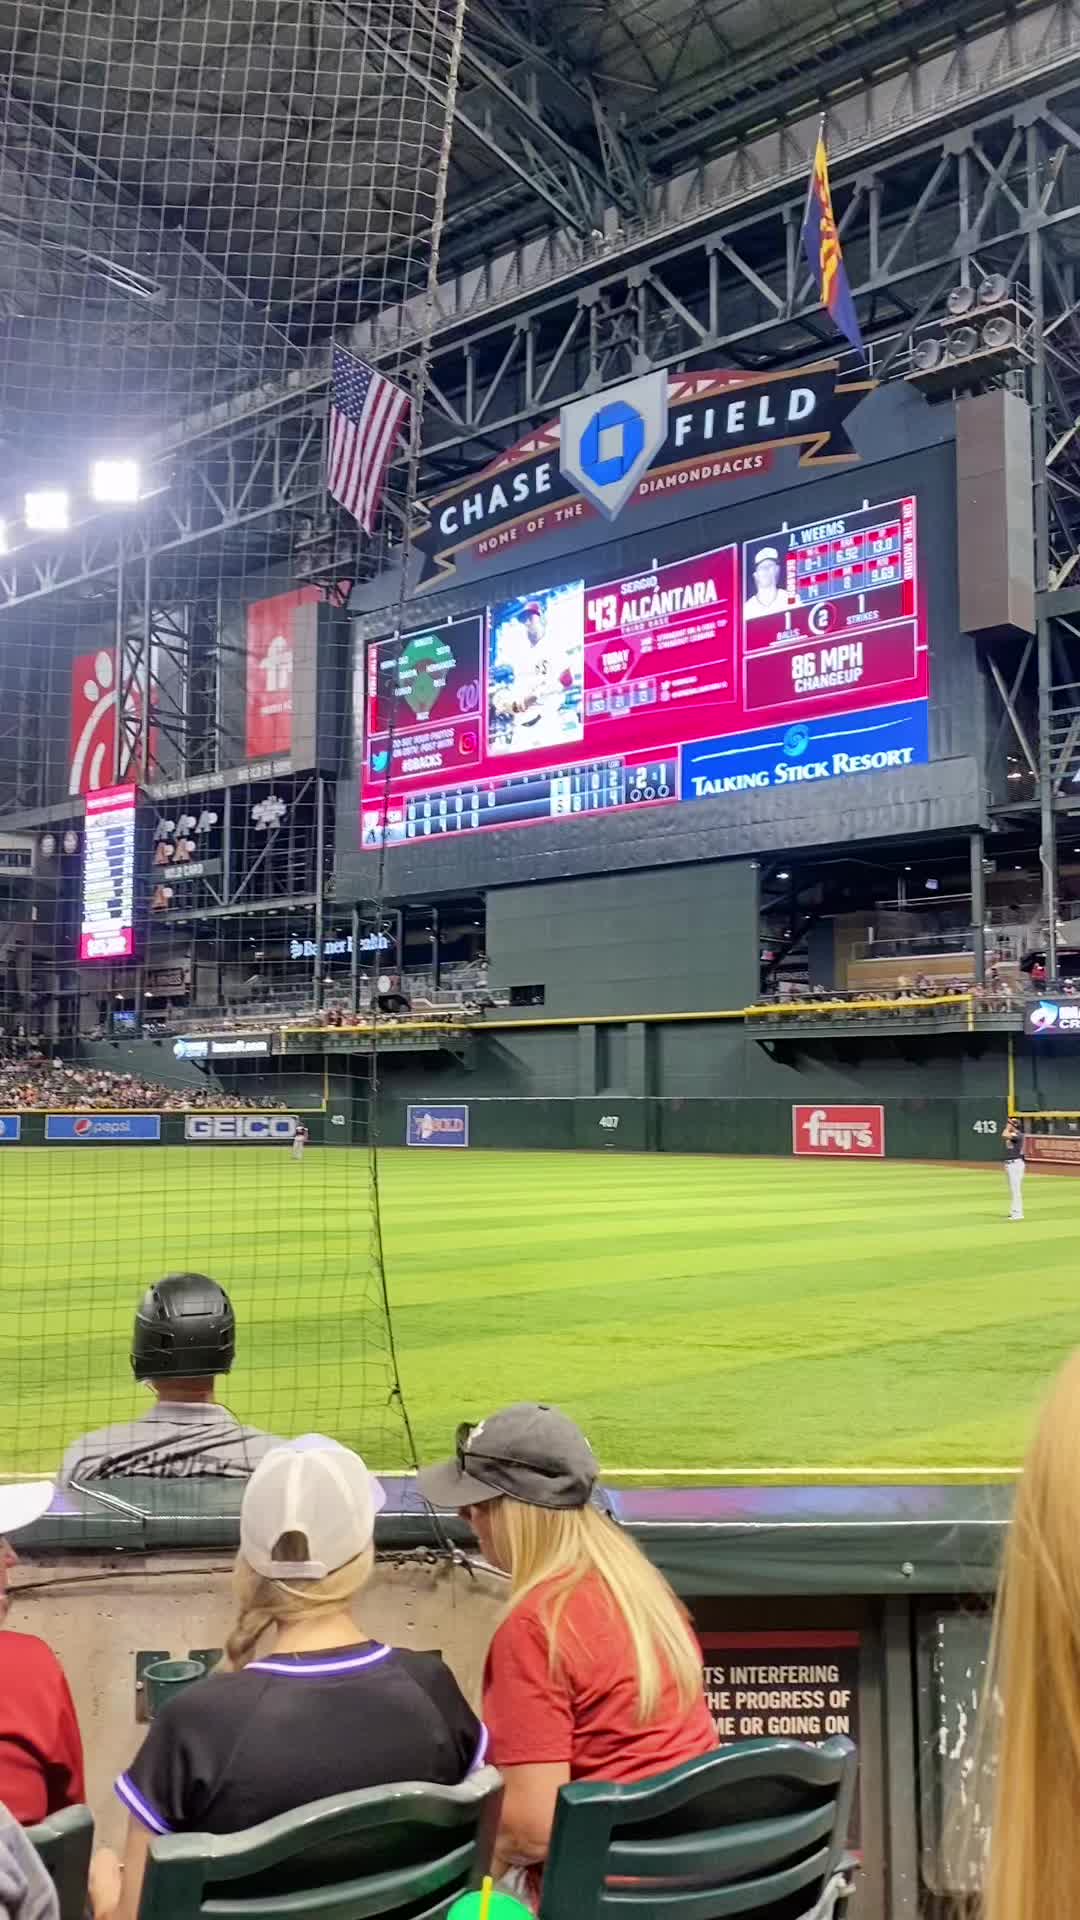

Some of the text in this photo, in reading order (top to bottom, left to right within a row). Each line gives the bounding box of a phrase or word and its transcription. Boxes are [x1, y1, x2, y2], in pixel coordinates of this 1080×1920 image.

[440, 388, 816, 535] CHASE FIELD
[478, 455, 764, 553] HOME OF THE DIAMONDBACKS
[800, 520, 846, 544] WEEMS
[620, 578, 719, 625] ALCÁNTARA
[858, 594, 866, 613] 1
[587, 594, 618, 633] 43
[784, 611, 792, 630] 1
[818, 608, 829, 627] 2
[791, 641, 864, 680] 86 MPH
[794, 667, 864, 693] CHANGEUP
[635, 766, 648, 790] 2
[691, 747, 915, 796] TALKING STICK RESORT
[92, 1120, 131, 1135] pepsi
[187, 1116, 297, 1138] GEICO
[599, 1116, 619, 1128] 407
[802, 1110, 874, 1150] fry's
[972, 1120, 997, 1134] 413
[730, 1665, 839, 1685] INTERFERING
[735, 1690, 825, 1710] PROGRESS
[829, 1690, 851, 1709] OF
[740, 1716, 764, 1735] OR
[768, 1716, 821, 1735] GOING
[825, 1716, 850, 1735] ON
